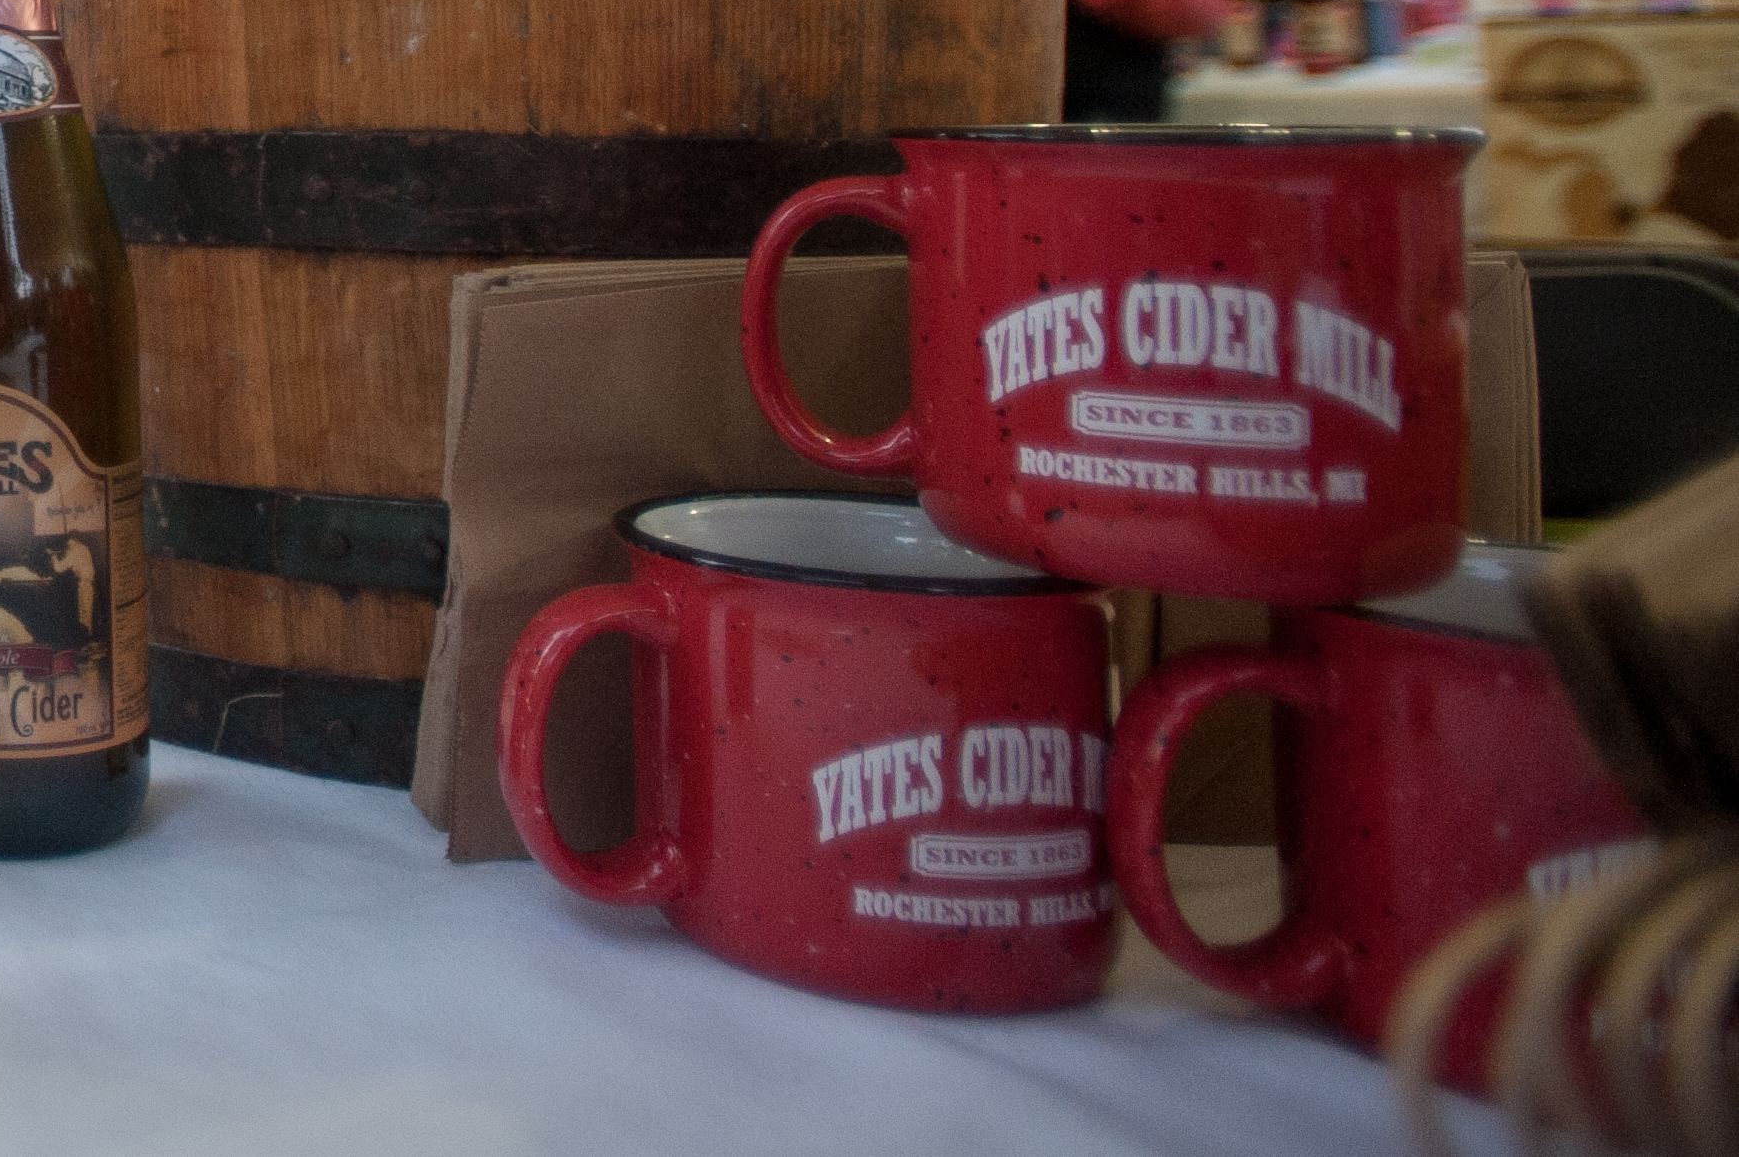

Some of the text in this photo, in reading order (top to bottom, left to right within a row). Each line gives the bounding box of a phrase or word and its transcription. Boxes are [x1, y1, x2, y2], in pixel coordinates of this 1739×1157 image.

[984, 281, 1402, 434] YATES CIDER MILL
[1086, 401, 1294, 437] SINCE 1863
[1019, 446, 1197, 495] ROCHESTER
[11, 683, 83, 738] Cider
[812, 733, 944, 844] YATES
[960, 726, 1074, 809] CIDER
[925, 847, 1017, 867] SINCE
[853, 886, 1021, 927] ROCHESTER
